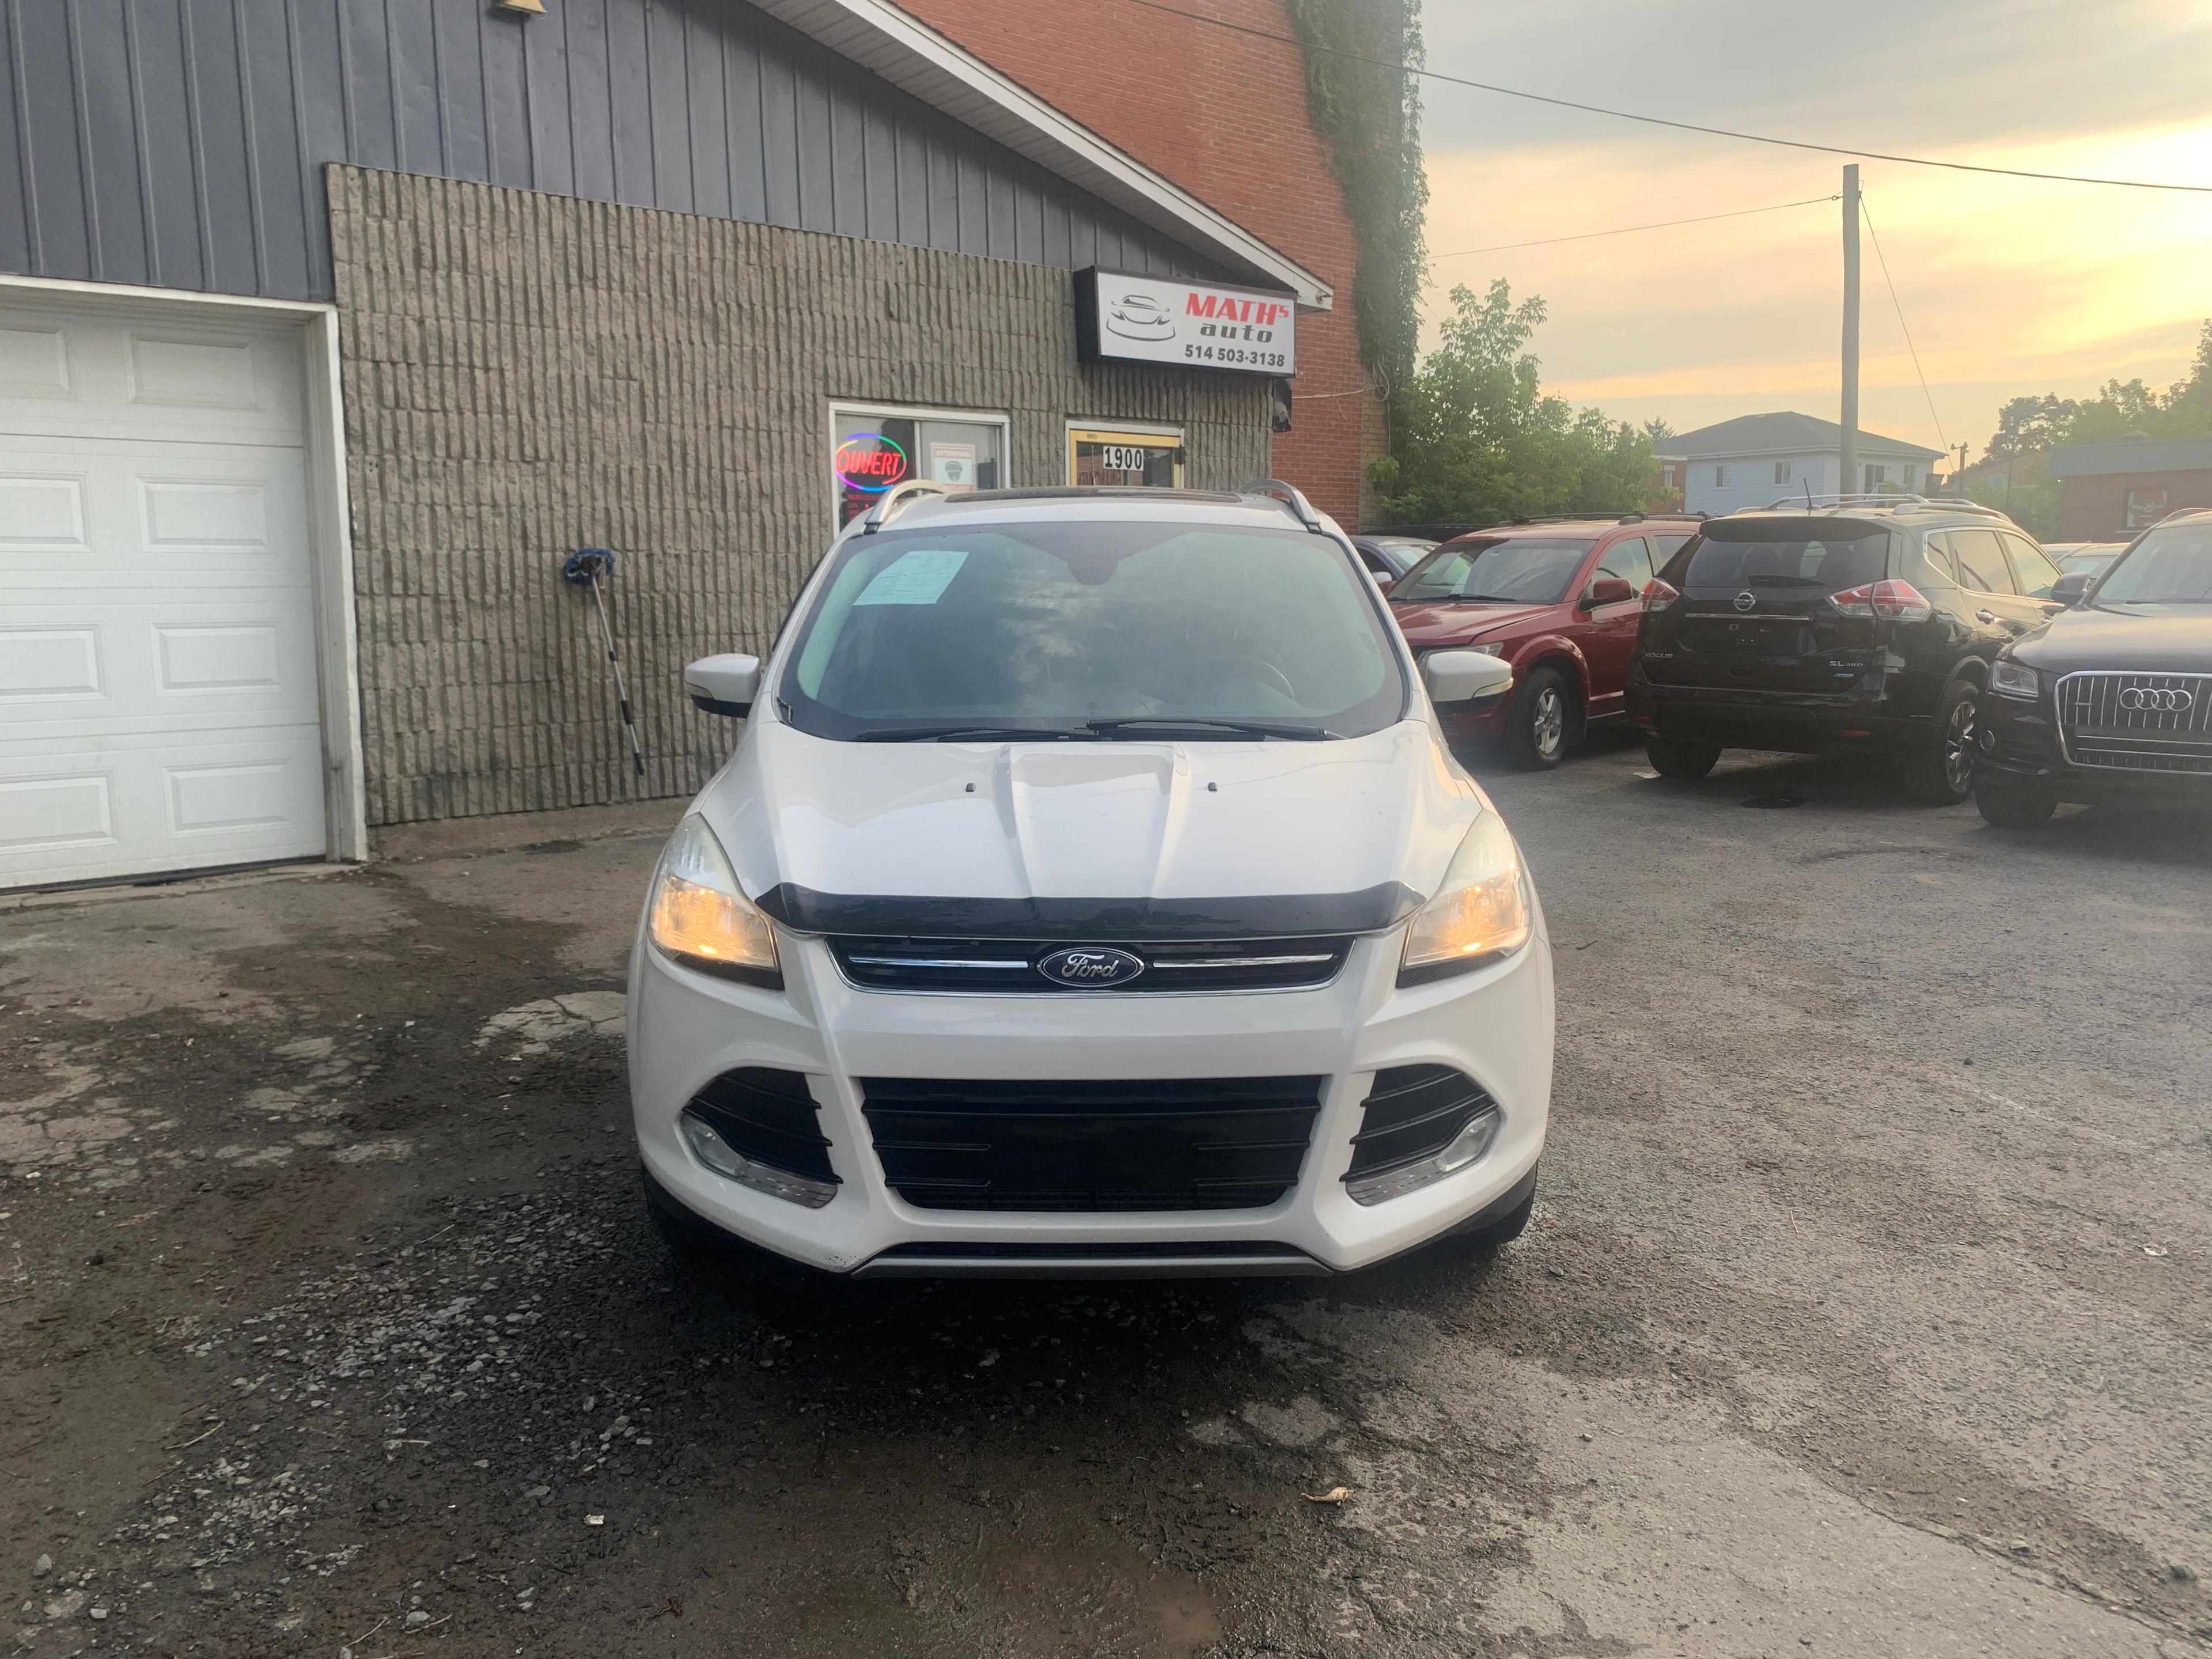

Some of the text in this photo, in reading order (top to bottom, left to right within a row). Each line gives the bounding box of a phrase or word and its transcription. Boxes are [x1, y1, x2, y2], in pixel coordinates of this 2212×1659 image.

[1200, 323, 1272, 343] auto
[1184, 344, 1285, 367] 514 503-3138
[836, 449, 902, 475] OUVERT
[1105, 447, 1142, 469] 1900
[1061, 953, 1119, 978] Ford
